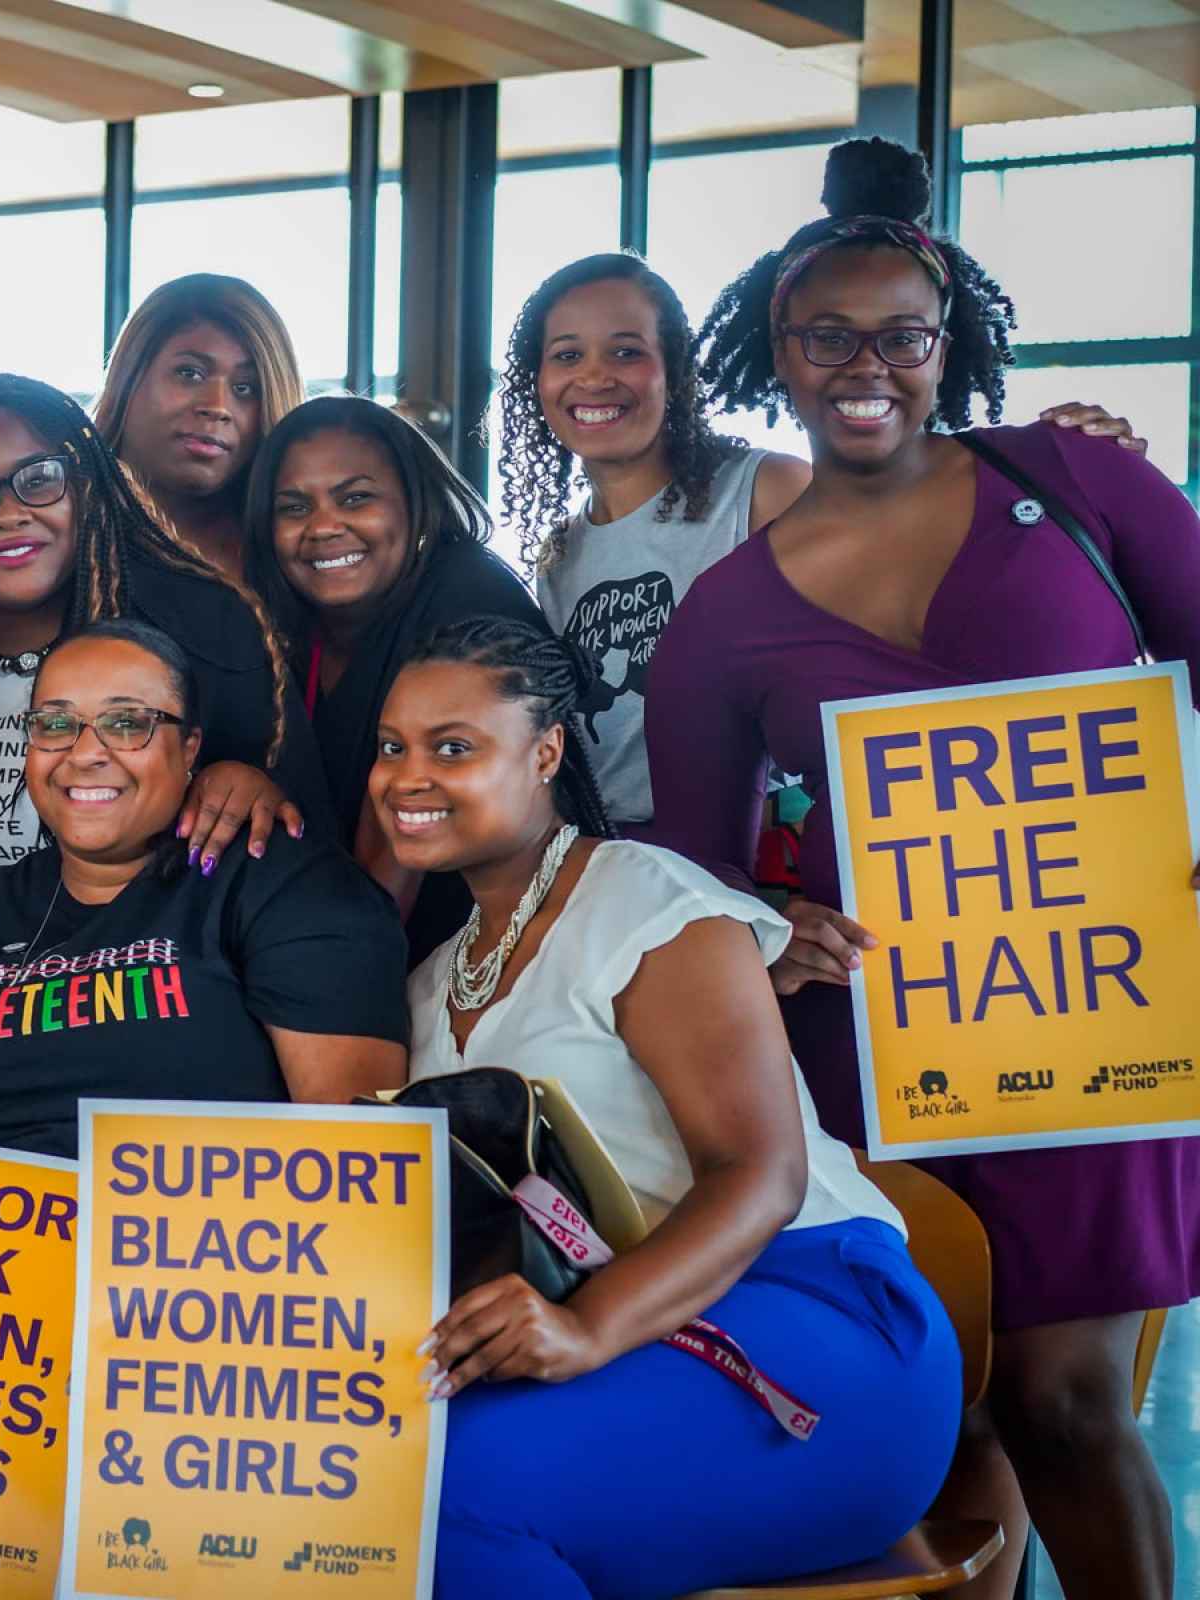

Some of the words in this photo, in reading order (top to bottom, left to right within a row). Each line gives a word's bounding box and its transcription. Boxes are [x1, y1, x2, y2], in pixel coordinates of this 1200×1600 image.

[580, 578, 667, 632] SUPPORT
[610, 602, 671, 644] WOMEN
[630, 634, 661, 665] GIR
[864, 707, 1147, 819] FREE
[866, 821, 1086, 922] THE
[888, 924, 1150, 1029] HAIR
[996, 1070, 1054, 1094] ACLU
[1110, 1058, 1195, 1076] WOMEN'S
[1112, 1074, 1159, 1092] FUND
[903, 1085, 919, 1101] BE
[908, 1102, 942, 1119] BLACK
[945, 1099, 971, 1115] GIRL
[110, 1142, 420, 1205] SUPPORT
[112, 1216, 329, 1276] BLACK
[107, 1284, 385, 1361] WOMEN,
[106, 1359, 402, 1438] FEMMES,
[98, 1429, 144, 1487] &
[163, 1434, 359, 1500] GIRLS
[107, 1552, 141, 1570] BLACK
[143, 1553, 169, 1572] GIRL
[199, 1533, 258, 1560] ACLU
[315, 1543, 397, 1562] WOMEN'S
[313, 1558, 359, 1576] FUND
